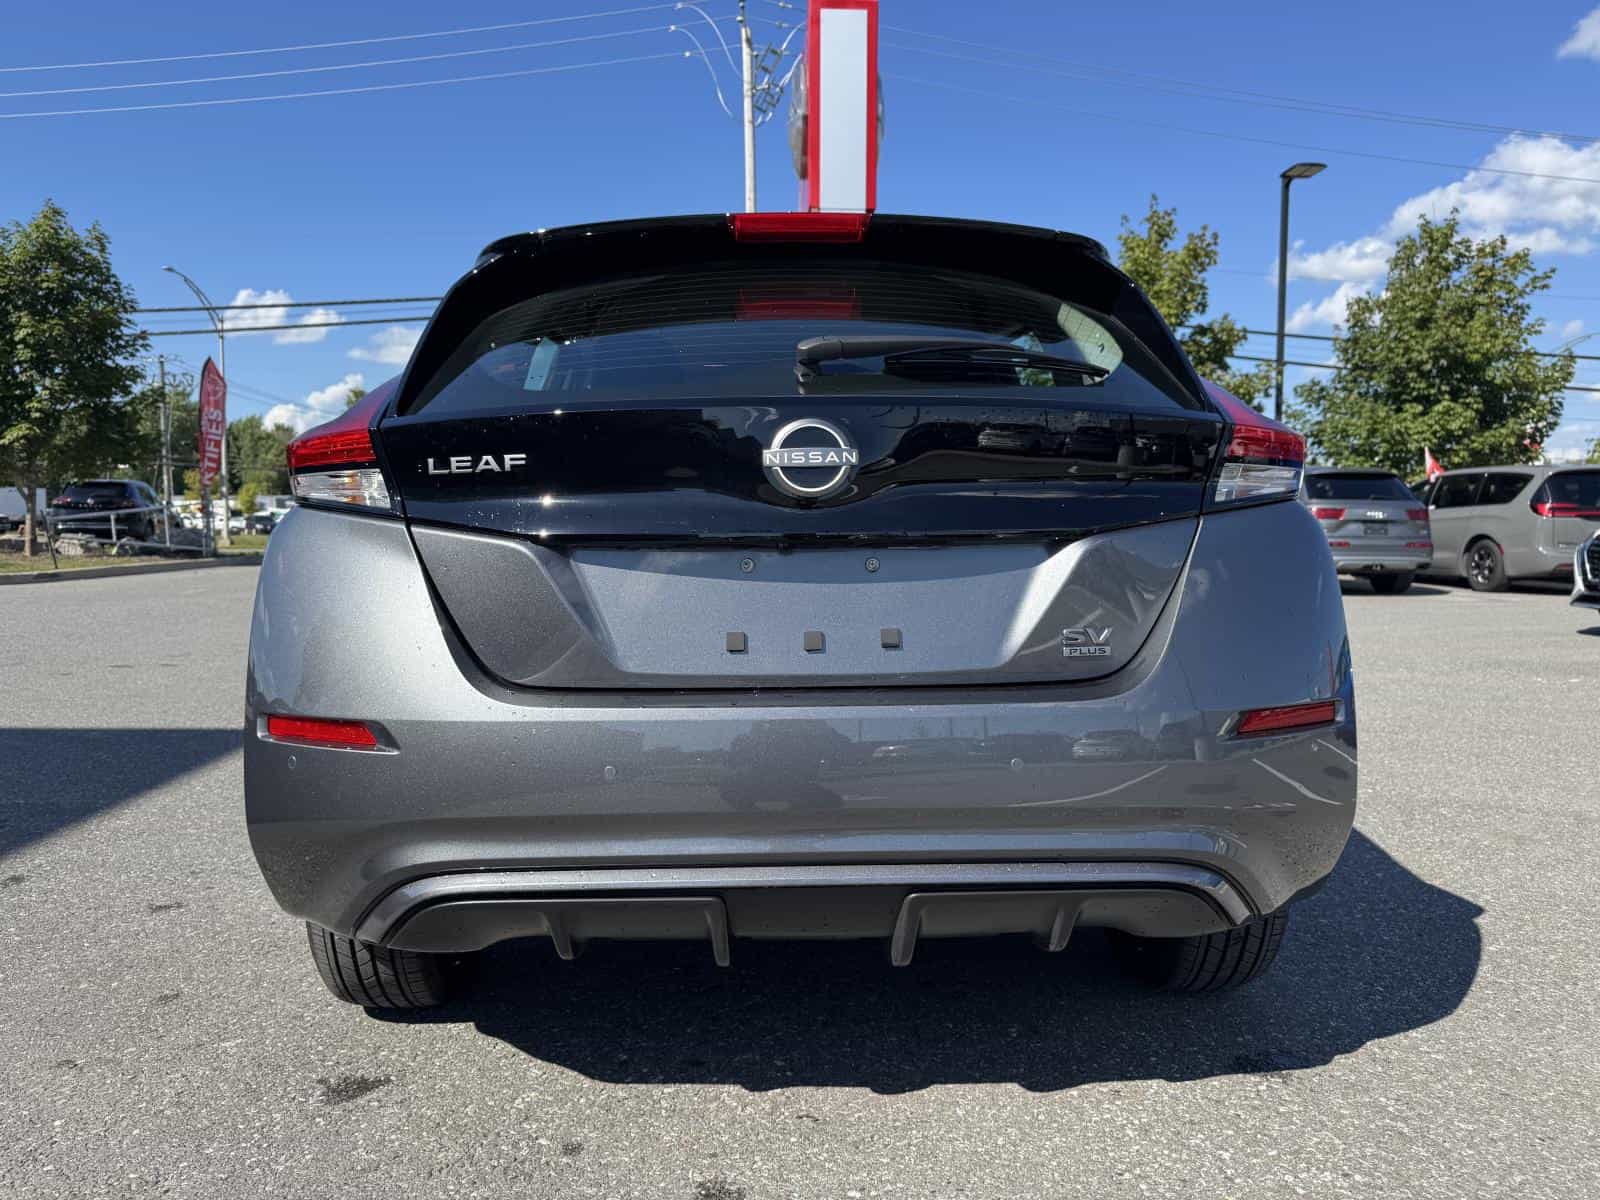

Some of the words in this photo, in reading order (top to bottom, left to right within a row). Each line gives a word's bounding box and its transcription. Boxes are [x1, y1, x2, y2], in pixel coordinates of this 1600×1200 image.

[427, 453, 527, 475] LEAF
[765, 450, 857, 465] NISSAN
[1062, 627, 1112, 645] SV
[1068, 646, 1108, 656] PLUS
